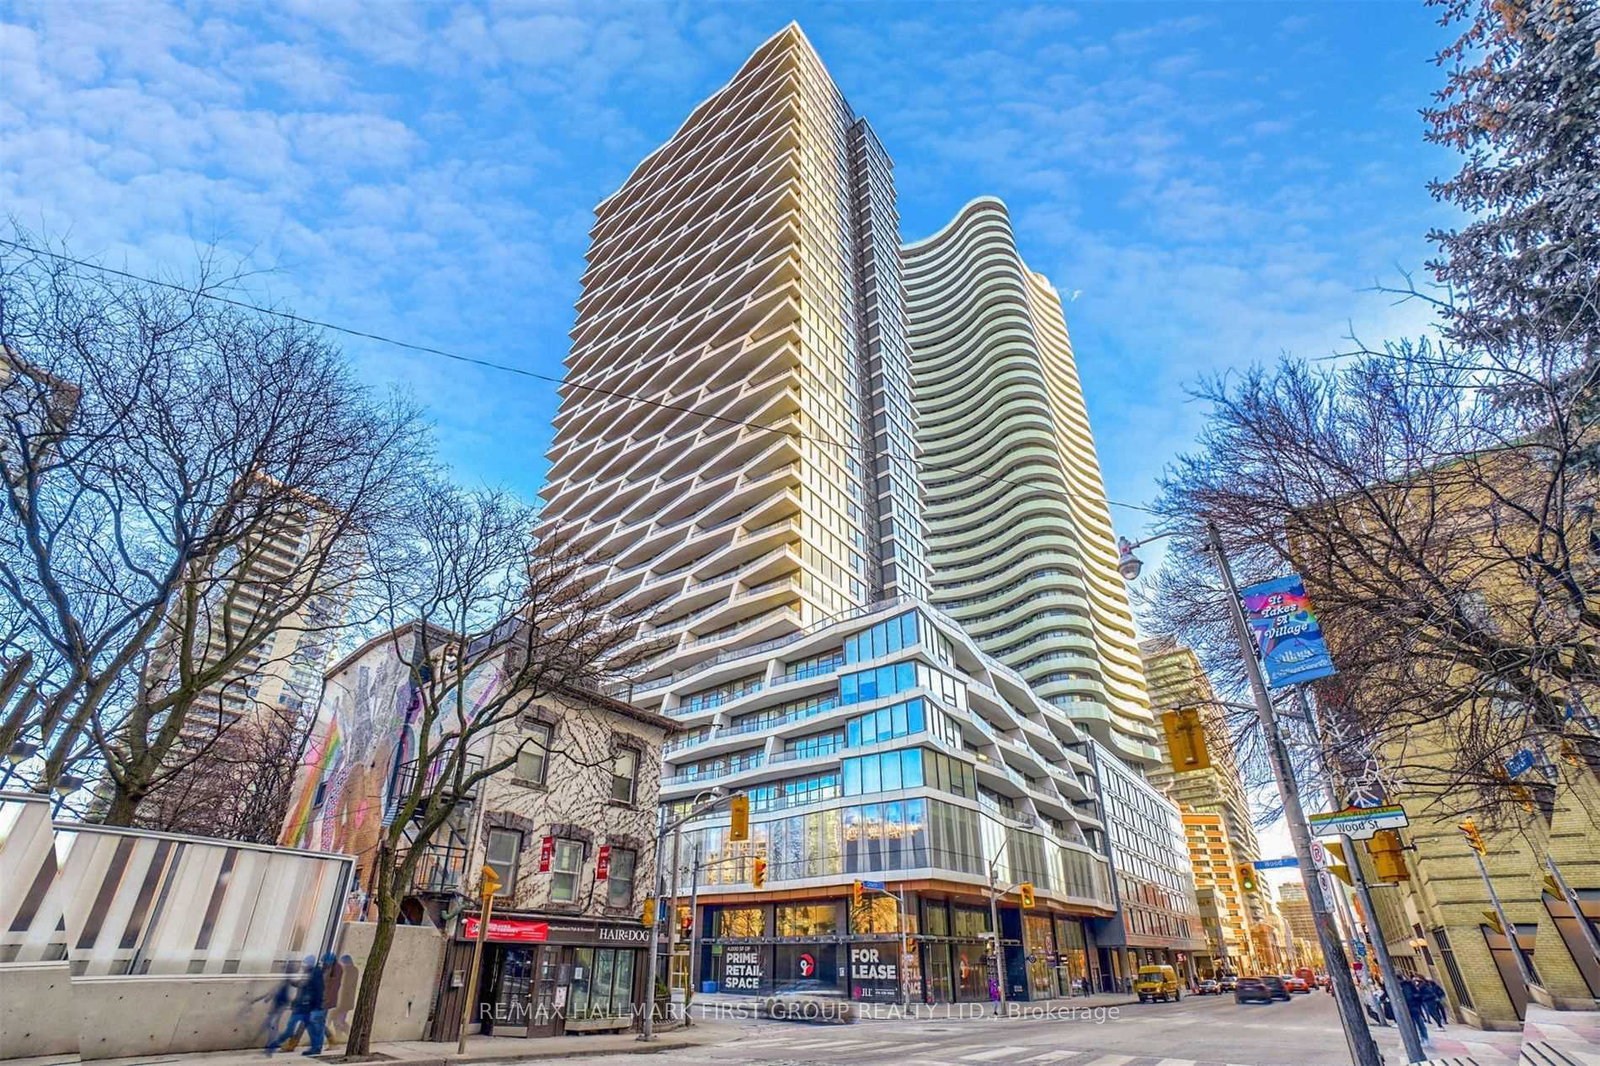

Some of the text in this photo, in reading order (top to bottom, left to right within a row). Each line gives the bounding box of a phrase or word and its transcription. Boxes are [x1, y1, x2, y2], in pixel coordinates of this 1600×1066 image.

[1268, 595, 1282, 605] It
[1261, 604, 1297, 618] Takes
[1264, 623, 1308, 638] Village
[1336, 819, 1380, 833] Wood St
[600, 928, 625, 940] HAIR
[628, 930, 650, 942] DOG
[726, 952, 758, 964] PRIME
[851, 949, 879, 963] FOR
[852, 964, 897, 980] LEASE
[725, 976, 760, 989] SPACE
